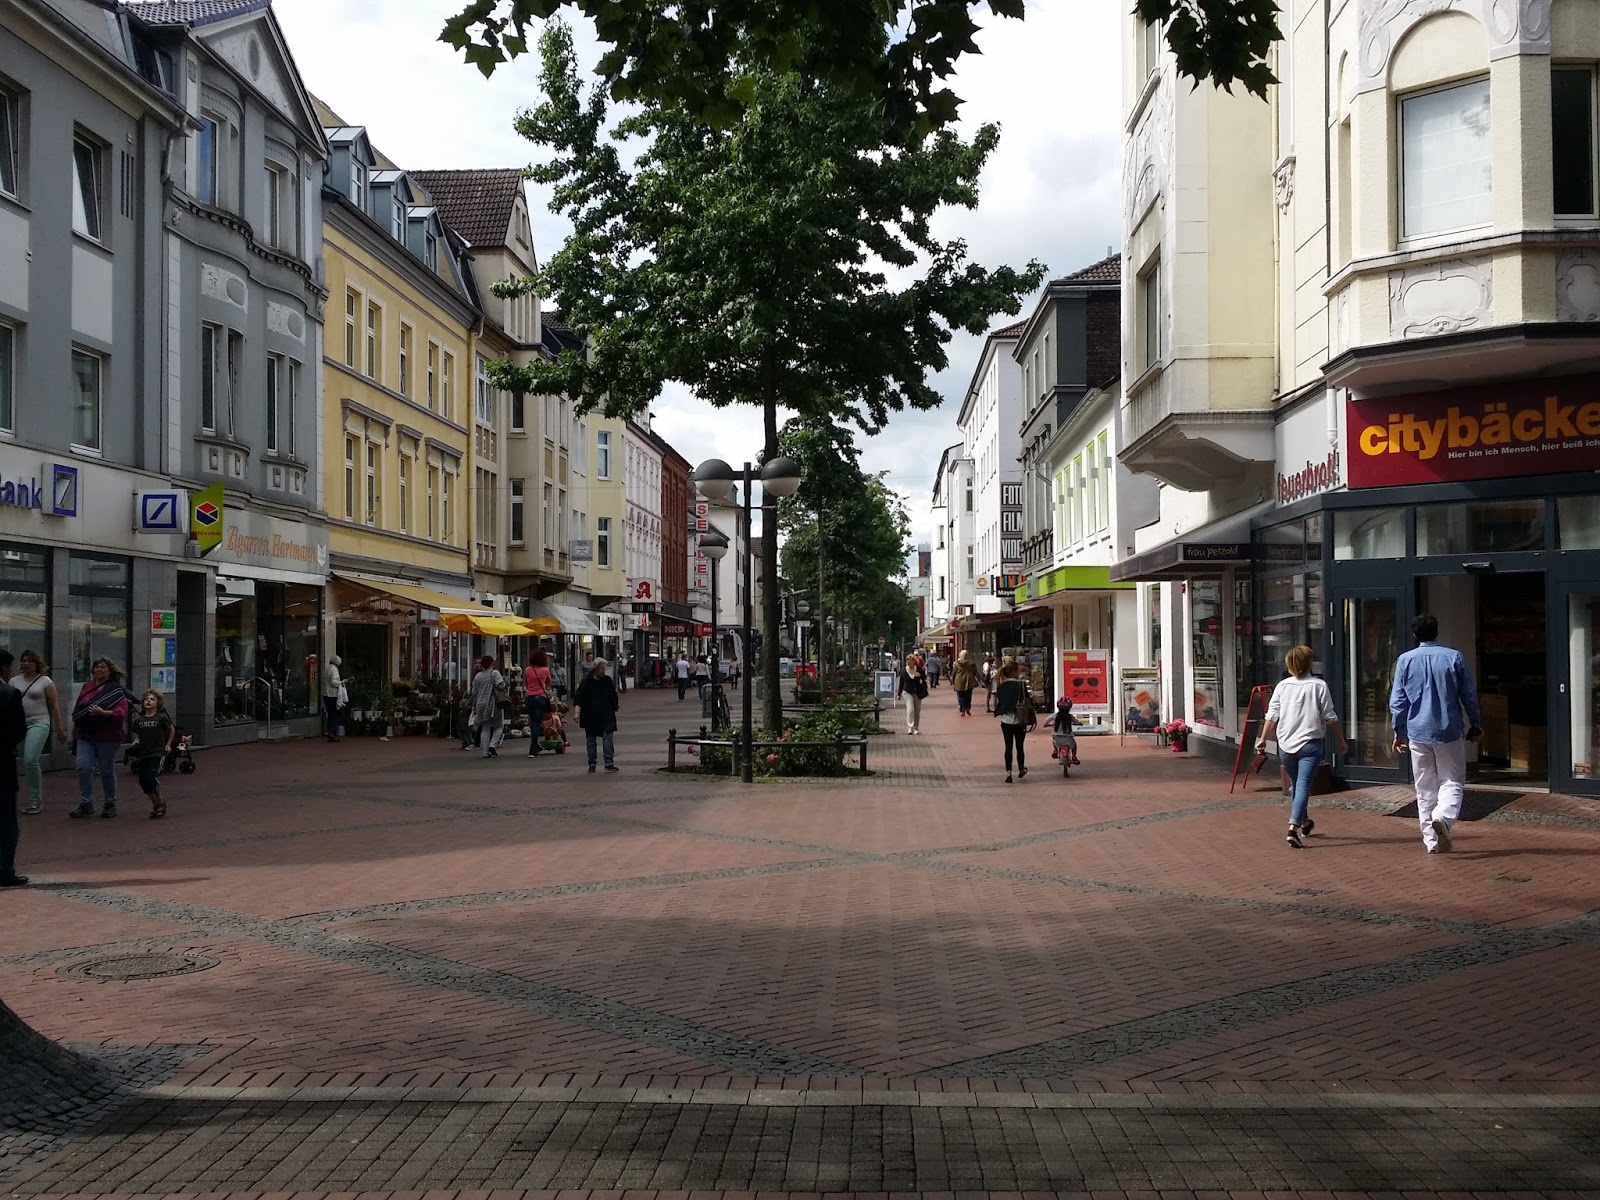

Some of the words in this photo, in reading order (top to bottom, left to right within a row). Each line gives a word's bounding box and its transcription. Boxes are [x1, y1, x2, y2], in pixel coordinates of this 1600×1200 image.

[1448, 451, 1467, 459] Hier
[1469, 449, 1482, 457] bin
[1485, 448, 1499, 456] ich
[1501, 444, 1539, 454] Mensch,
[1542, 442, 1560, 451] hier
[1563, 440, 1583, 448] beiß
[1586, 439, 1600, 447] ich
[225, 526, 269, 557] Zigarren
[272, 534, 316, 562] Hartmann
[1188, 548, 1206, 558] frau
[1207, 545, 1239, 558] petzold
[664, 625, 685, 634] NKD
